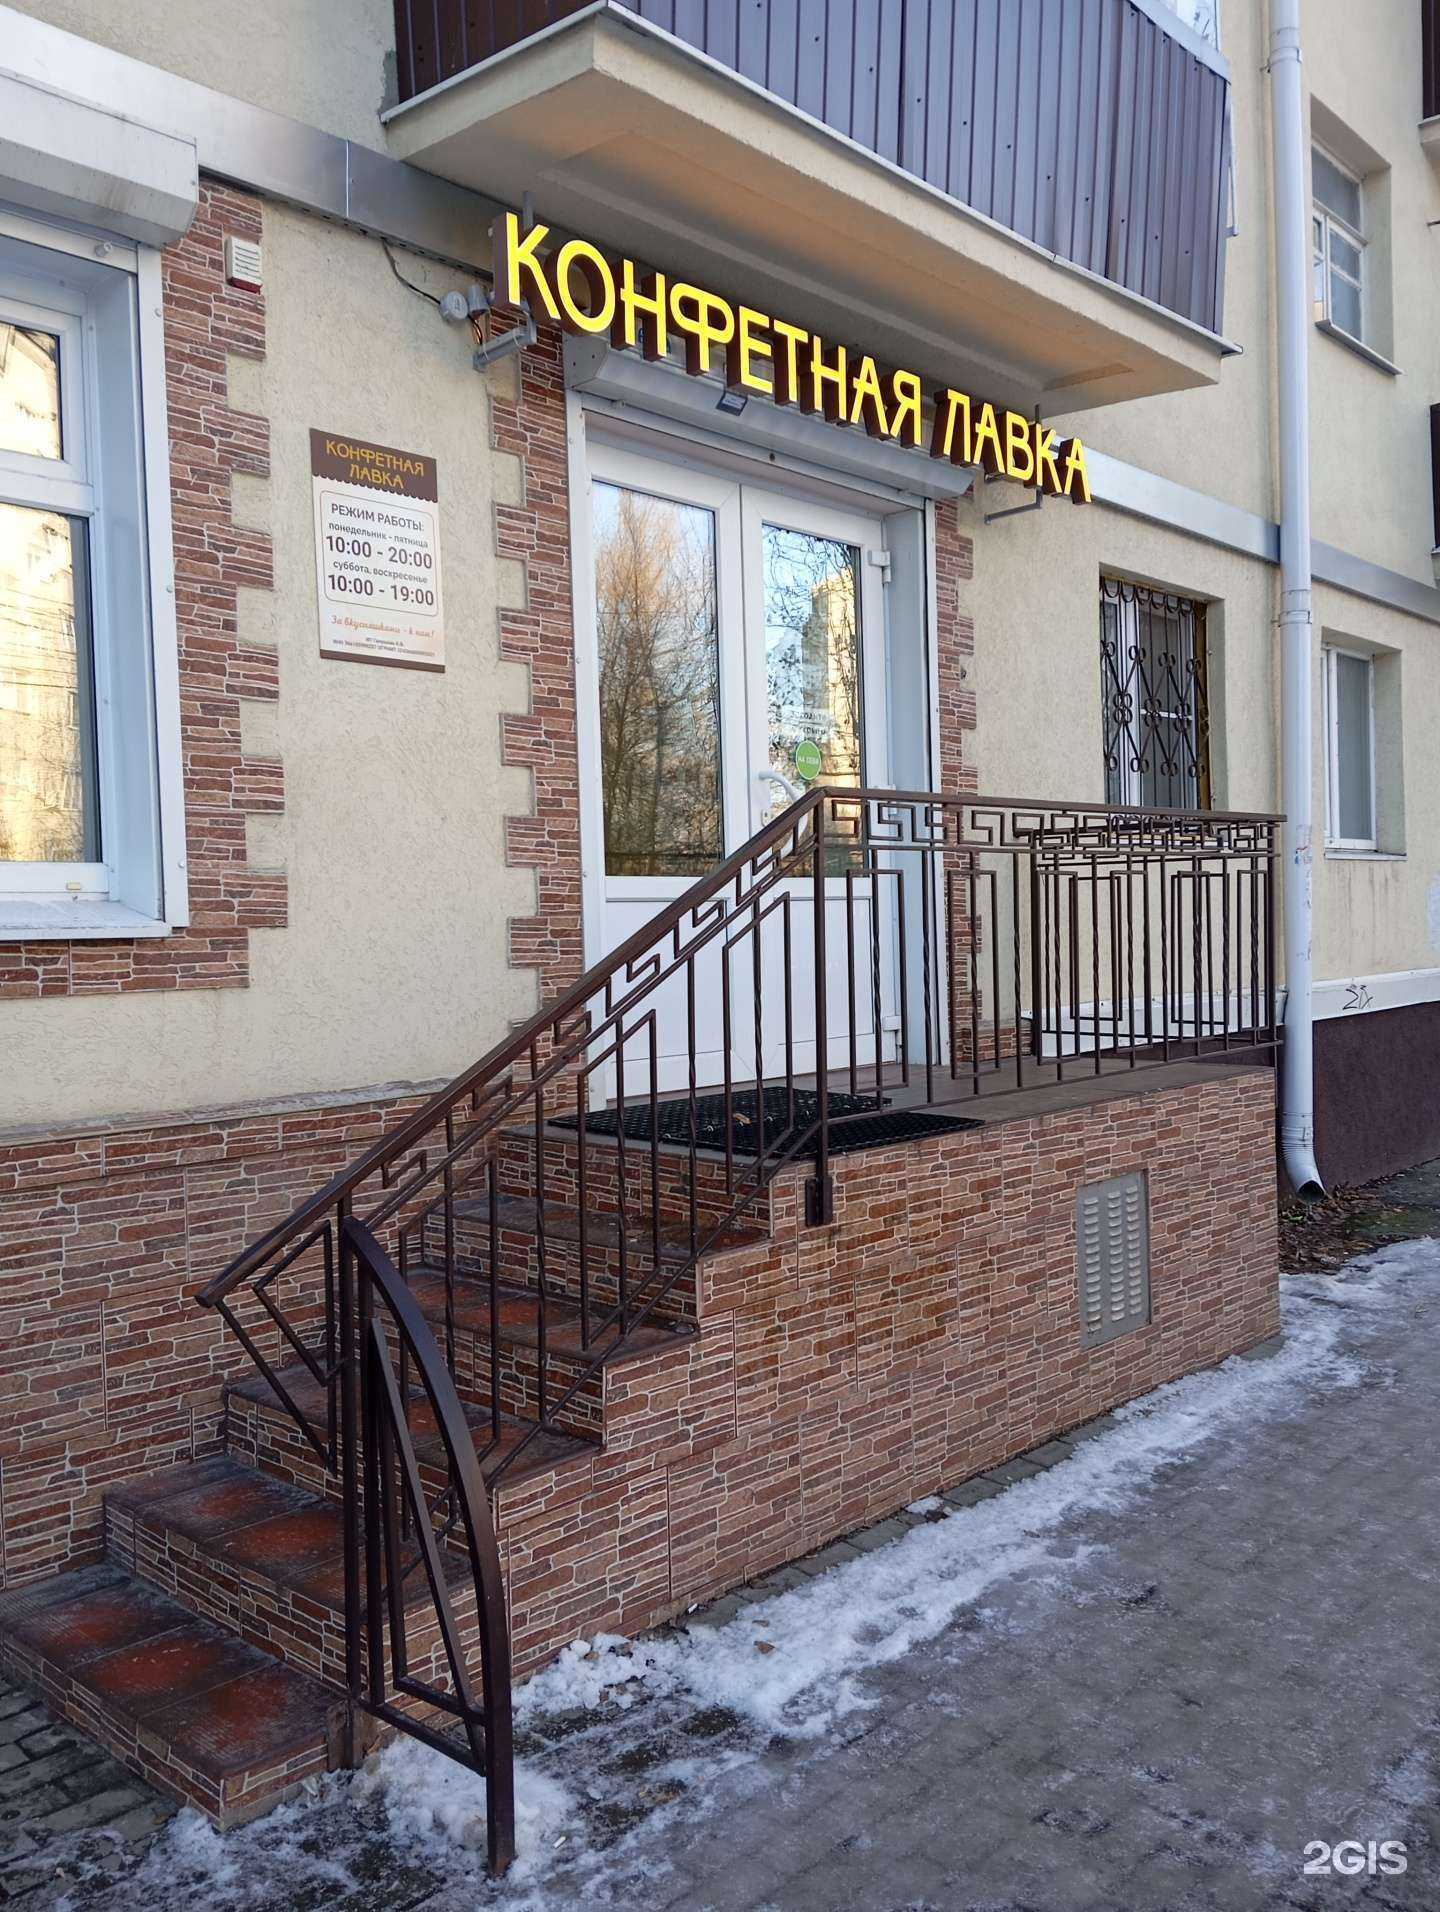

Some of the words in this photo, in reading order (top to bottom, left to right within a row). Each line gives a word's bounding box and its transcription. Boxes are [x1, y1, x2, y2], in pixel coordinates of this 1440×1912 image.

[506, 211, 922, 447] КОНФЕТНАЯ
[943, 388, 1091, 503] ЛАВКА
[326, 440, 425, 477] КОНФЕТНАЯ
[350, 464, 404, 489] ЛАВКА
[331, 503, 375, 522] РЕЖИМ
[377, 513, 425, 531] РАБОТЫ:
[329, 522, 387, 540] понедельник
[394, 534, 429, 549] пятница
[326, 535, 372, 558] 10:00
[388, 546, 432, 569] 20:00
[333, 560, 372, 575] суббота,
[328, 574, 374, 597] 10:00
[391, 584, 434, 606] 19:00
